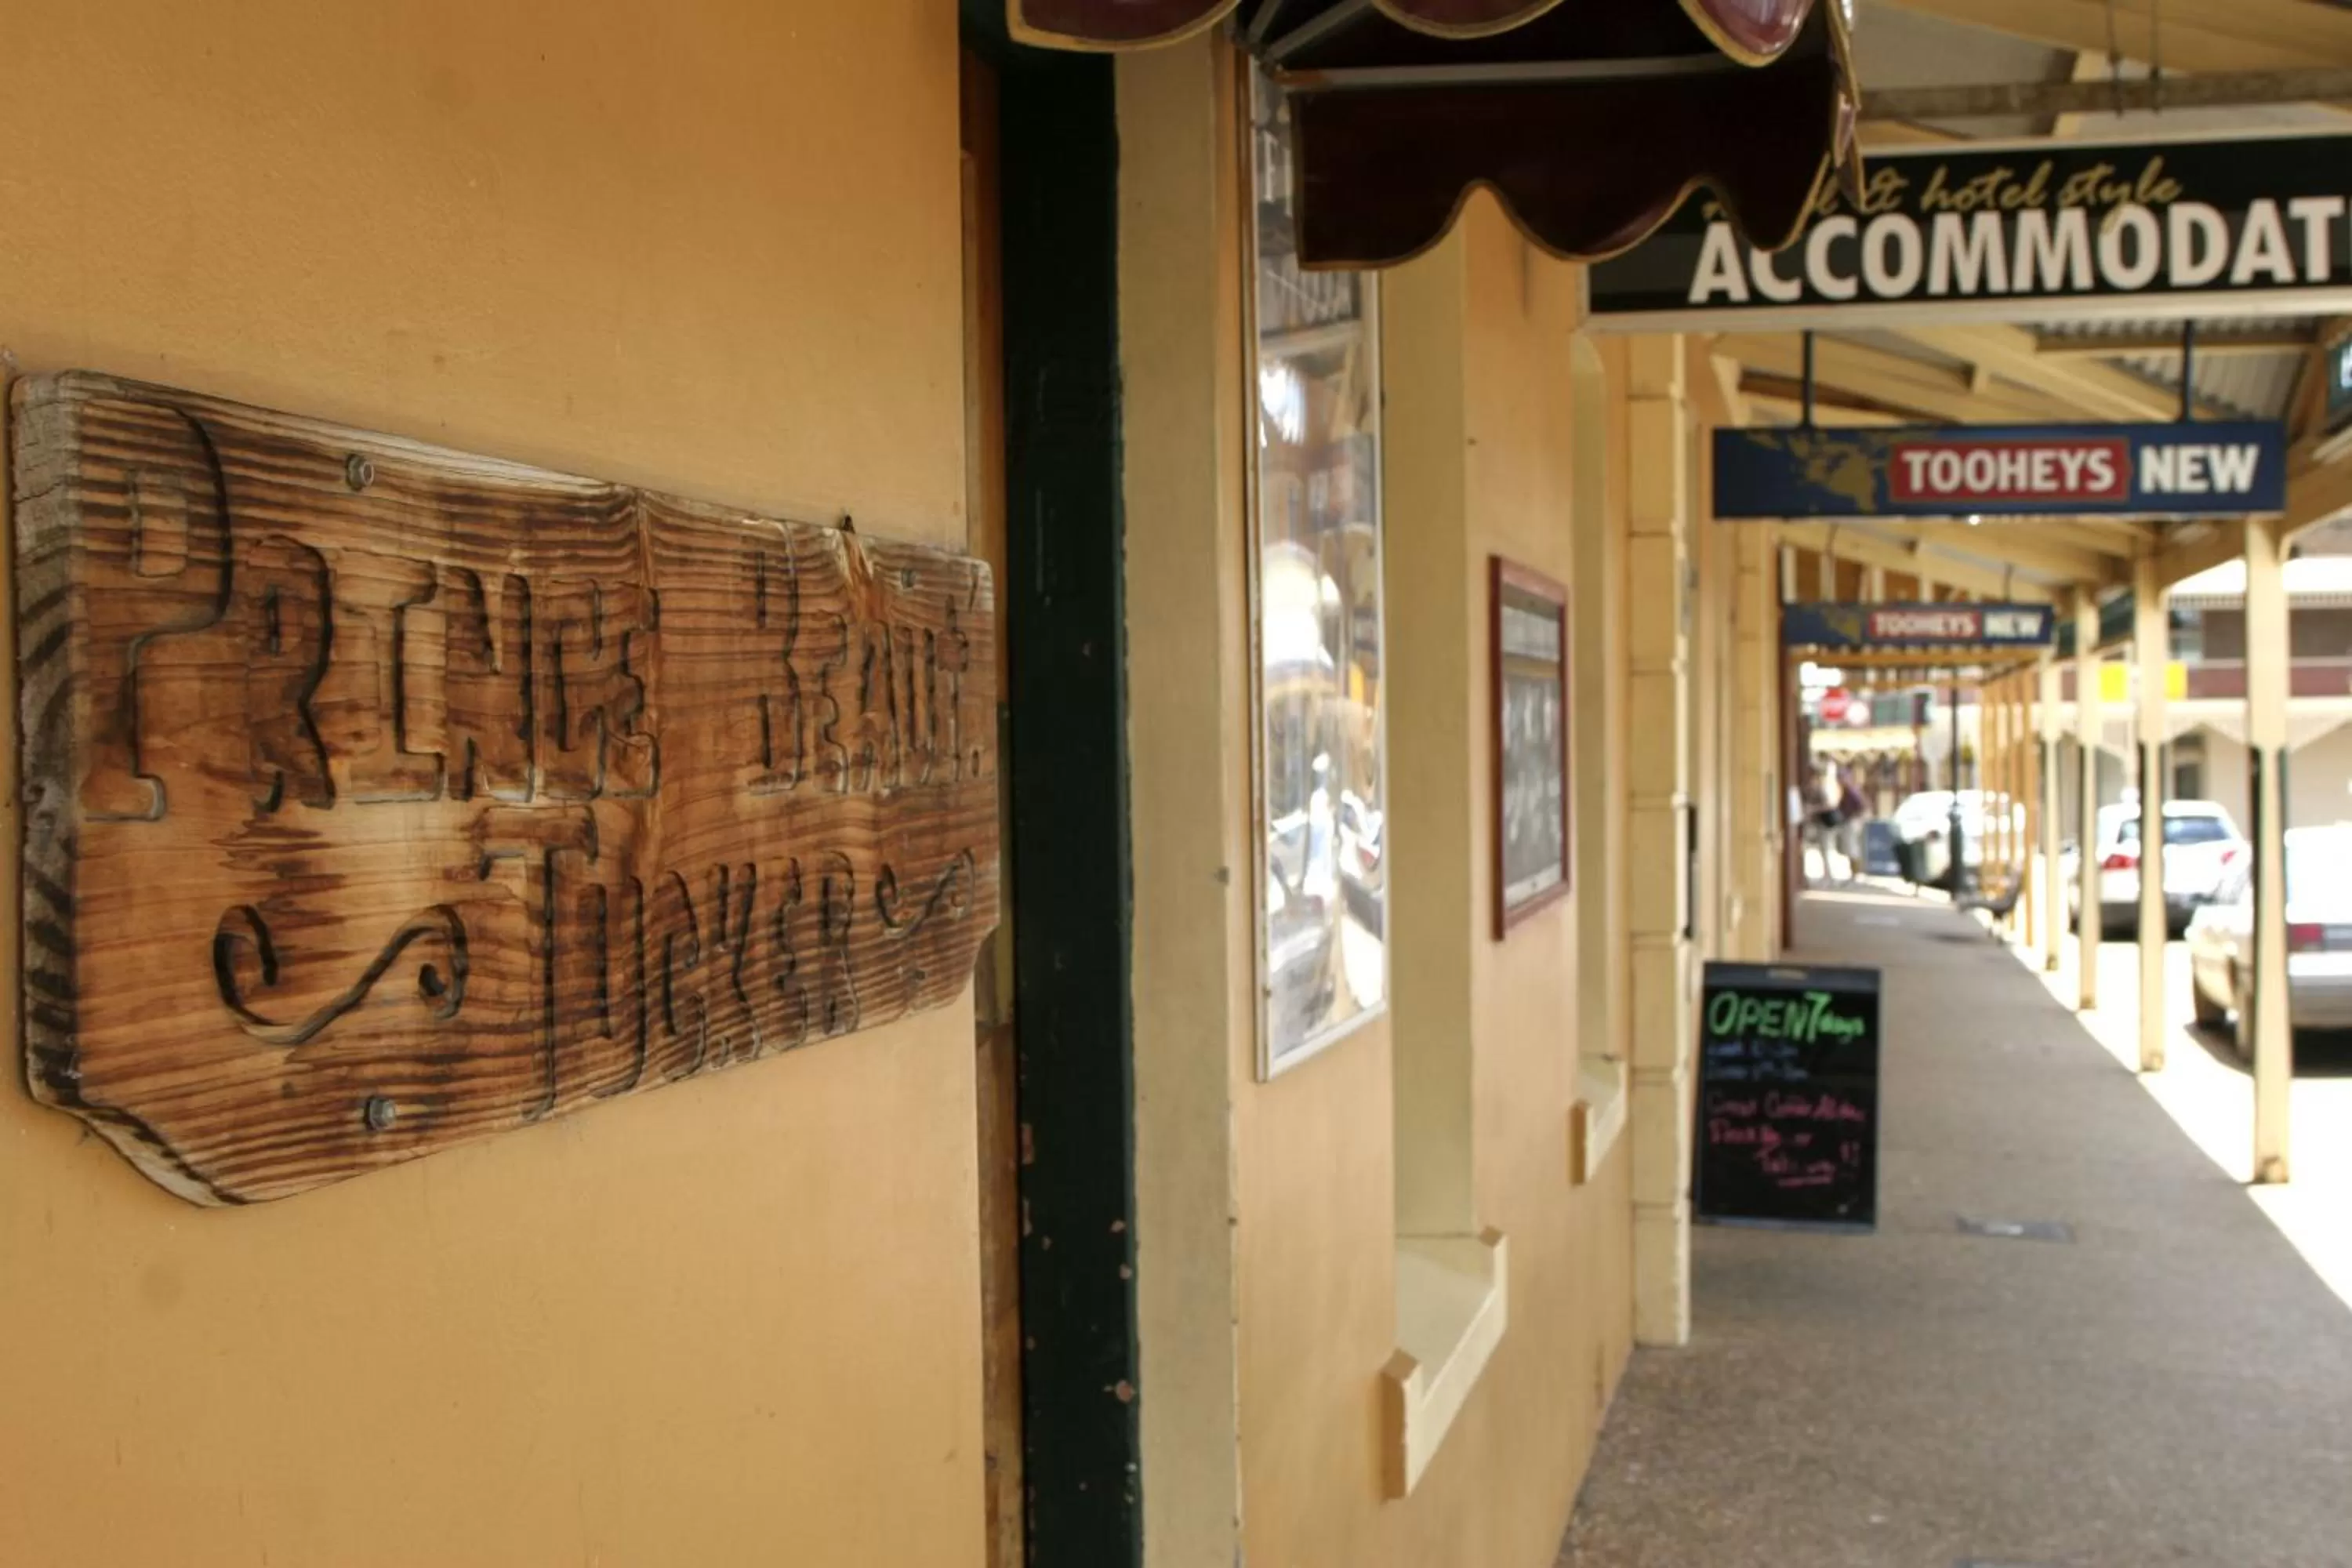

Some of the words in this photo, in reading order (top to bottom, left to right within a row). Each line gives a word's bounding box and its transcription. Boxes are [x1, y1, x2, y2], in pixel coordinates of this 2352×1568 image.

[1919, 159, 2049, 212] hotel
[2056, 154, 2183, 236] style
[1687, 194, 2352, 304] ACCOMMODAT
[1901, 447, 2116, 492] TOOHEYS
[2138, 444, 2260, 493] NEW
[1708, 990, 1809, 1041] OPEN
